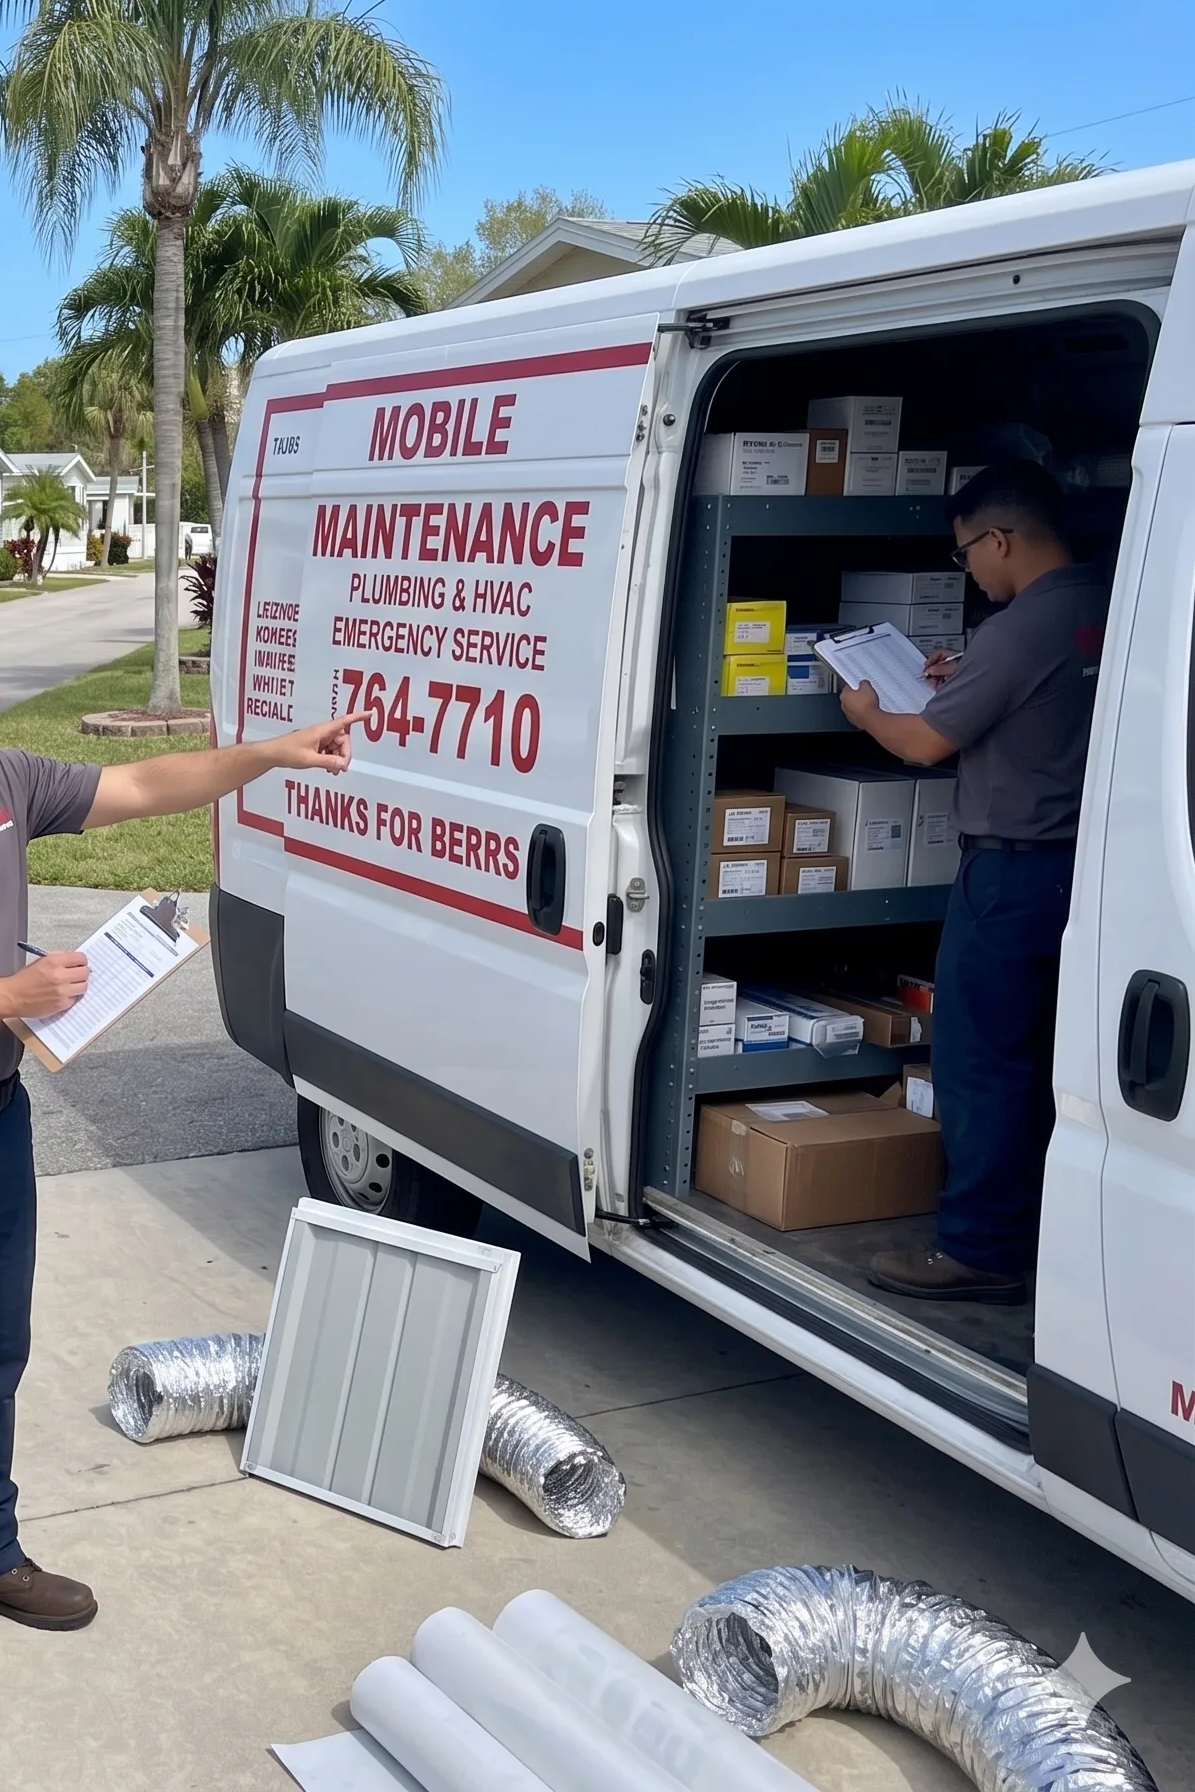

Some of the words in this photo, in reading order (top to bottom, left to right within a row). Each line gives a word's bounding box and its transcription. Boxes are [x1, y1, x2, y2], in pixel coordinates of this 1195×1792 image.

[369, 394, 517, 461] MOBILE
[313, 501, 590, 567] MAINTENANCE
[350, 573, 445, 609] PLUMBING
[452, 579, 465, 612] &
[473, 580, 532, 617] HVAC
[332, 616, 448, 658] EMERGENCY
[452, 628, 547, 671] SERVICE
[342, 669, 540, 773] 764-7710
[285, 779, 368, 836] THANKS
[377, 803, 422, 853] FOR
[431, 817, 519, 880] BERRS
